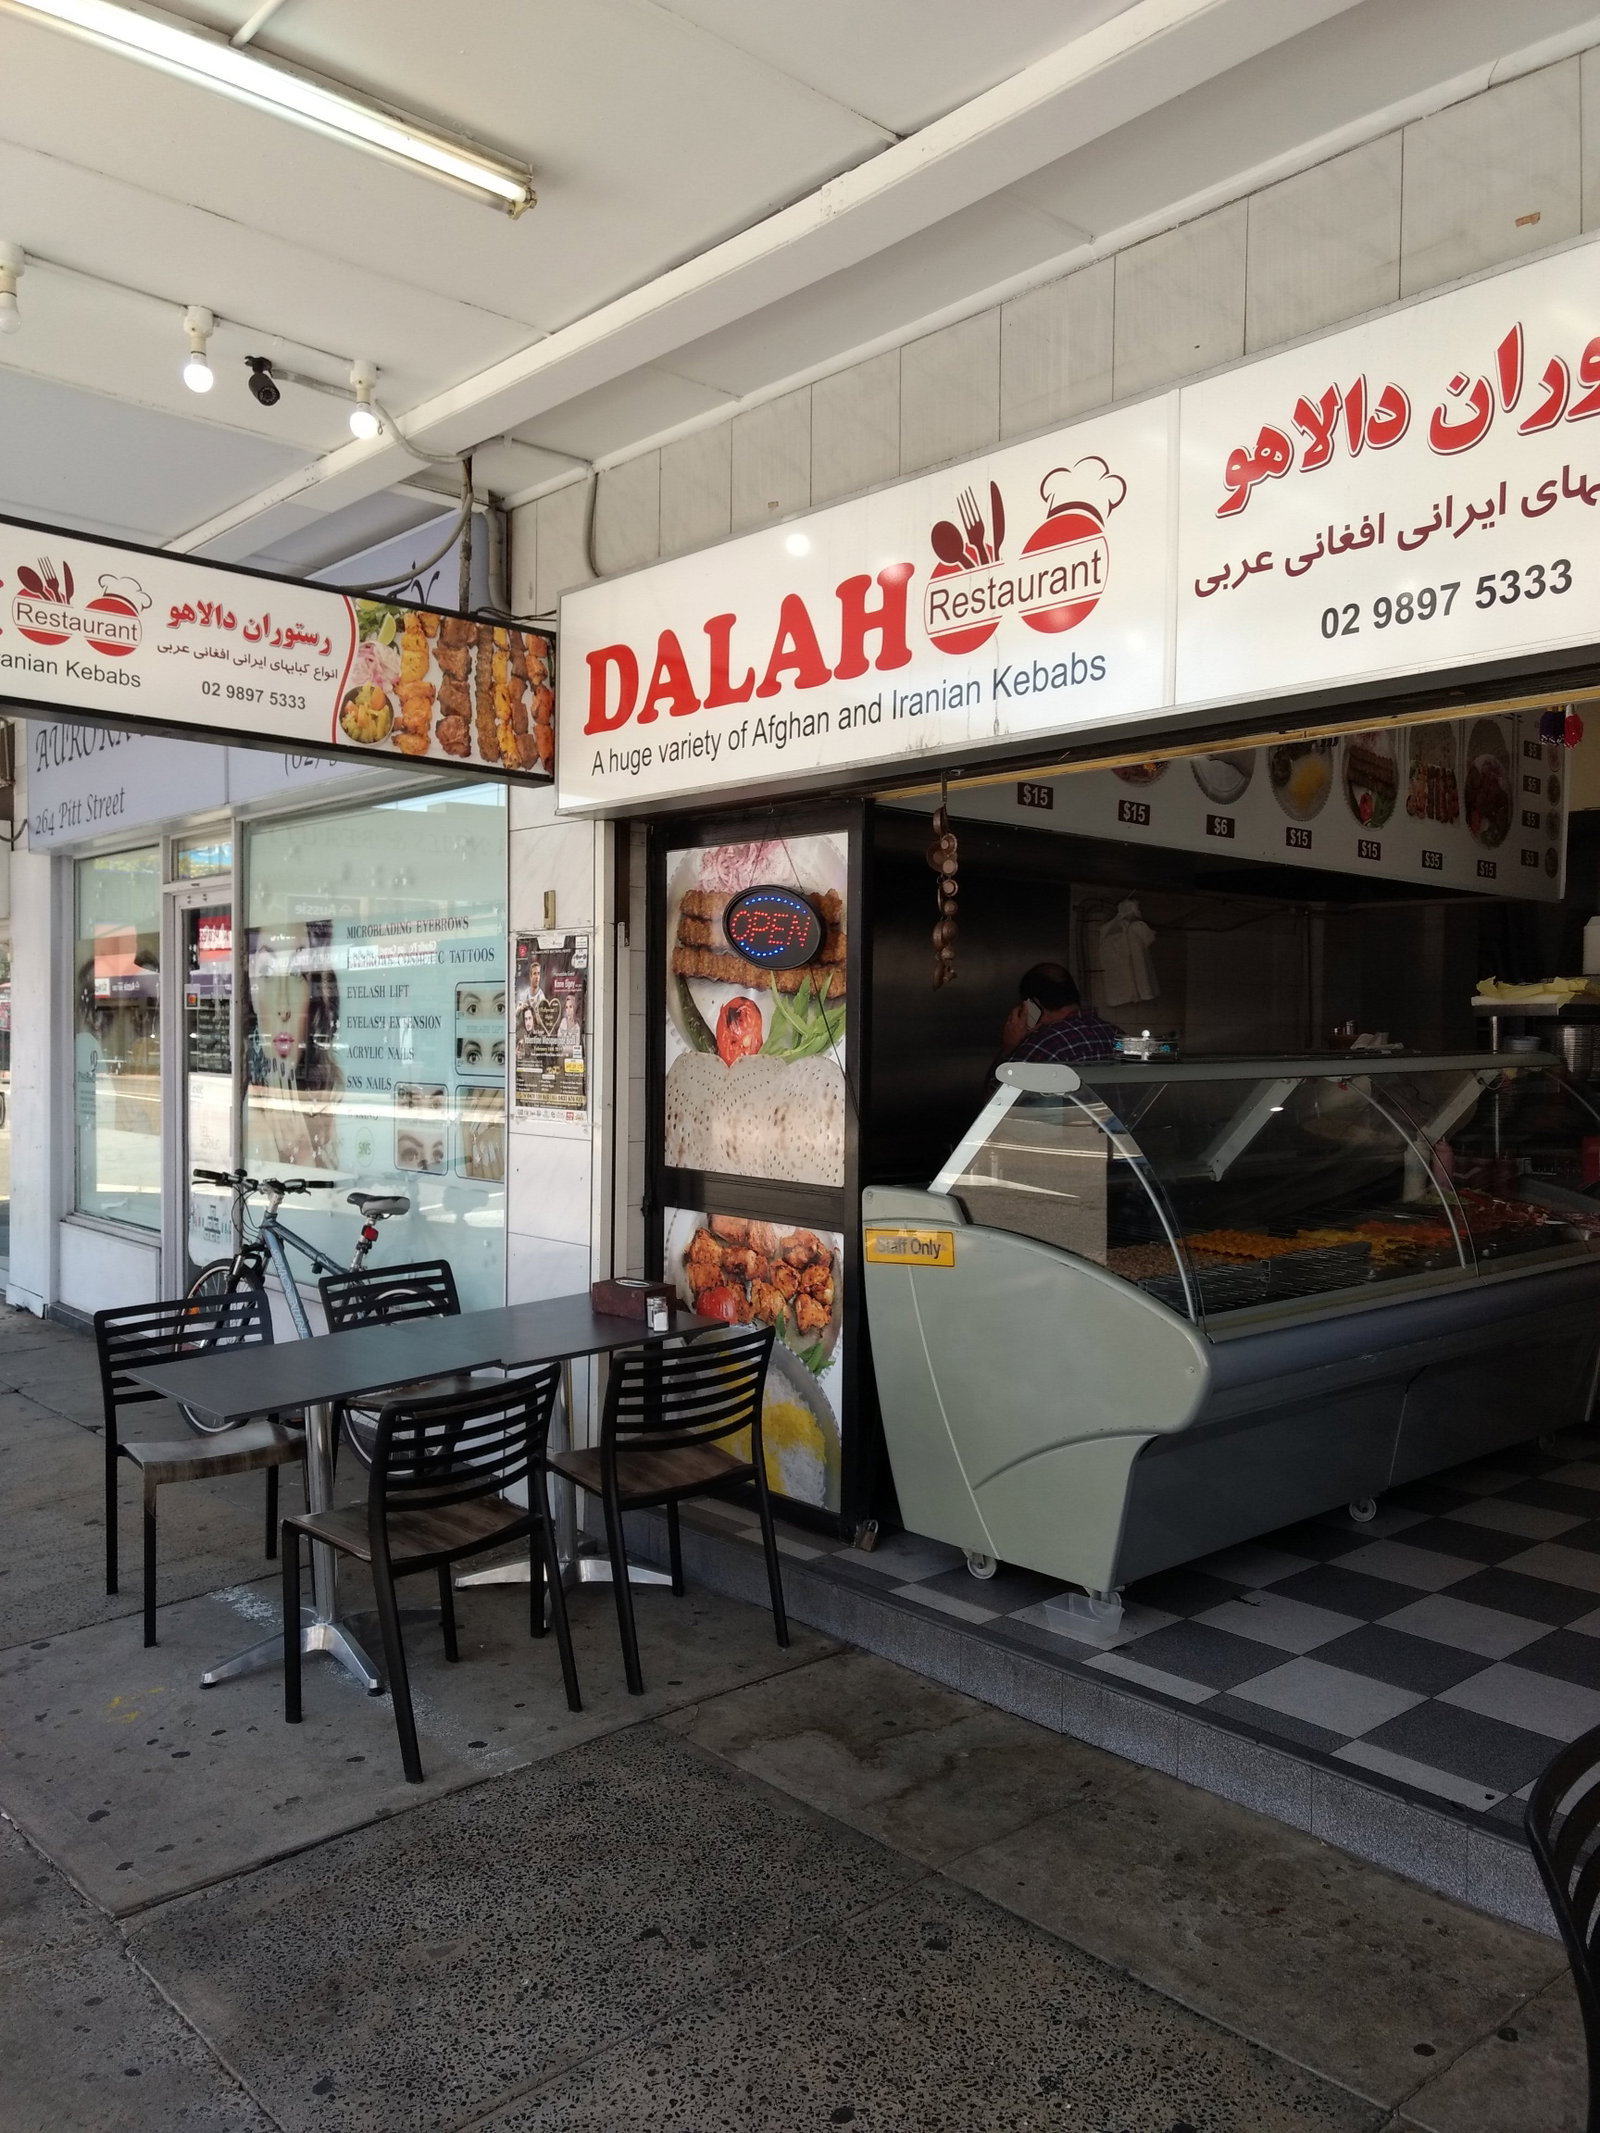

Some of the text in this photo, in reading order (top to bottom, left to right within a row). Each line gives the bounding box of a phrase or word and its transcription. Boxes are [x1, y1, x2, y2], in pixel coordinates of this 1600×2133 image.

[1215, 373, 1412, 519] دالاهو
[1397, 481, 1507, 552] ایرانی
[1285, 512, 1385, 578] افغانی
[1194, 547, 1273, 598] عربی
[928, 549, 1102, 625] Restaurant
[1321, 558, 1572, 639] 02 9897 5333
[16, 602, 138, 641] Restaurant
[167, 600, 334, 657] رستوران دالاهو
[157, 641, 190, 655] عربی
[193, 646, 229, 661] افغانی
[0, 653, 141, 688] anian Kebabs
[232, 653, 267, 669] ایرانی
[313, 666, 338, 682] انواع
[202, 681, 306, 710] 02 9897 5333
[591, 652, 1108, 776] A huge variety of Afghan and Iranian Kebabs
[1023, 784, 1048, 806] $15
[35, 787, 125, 836] 264 Pitt Street
[1123, 801, 1146, 822] $15
[1214, 817, 1228, 835] $6
[1290, 829, 1309, 846] $15
[1361, 841, 1378, 858] $15
[1424, 851, 1440, 868] $35
[1479, 861, 1494, 877] $15
[346, 915, 470, 939] MICROBLADING EYEBROWS
[730, 909, 811, 948] OPEN
[450, 947, 495, 963] TATTOOS
[346, 984, 410, 999] EYELASH LIFT
[346, 1015, 386, 1029] EYELASH
[389, 1015, 442, 1030] EXTENSION
[346, 1046, 415, 1060] ACRYLIC NAILS
[346, 1076, 392, 1091] SNS NAILS
[877, 1236, 942, 1260] Staff Only
